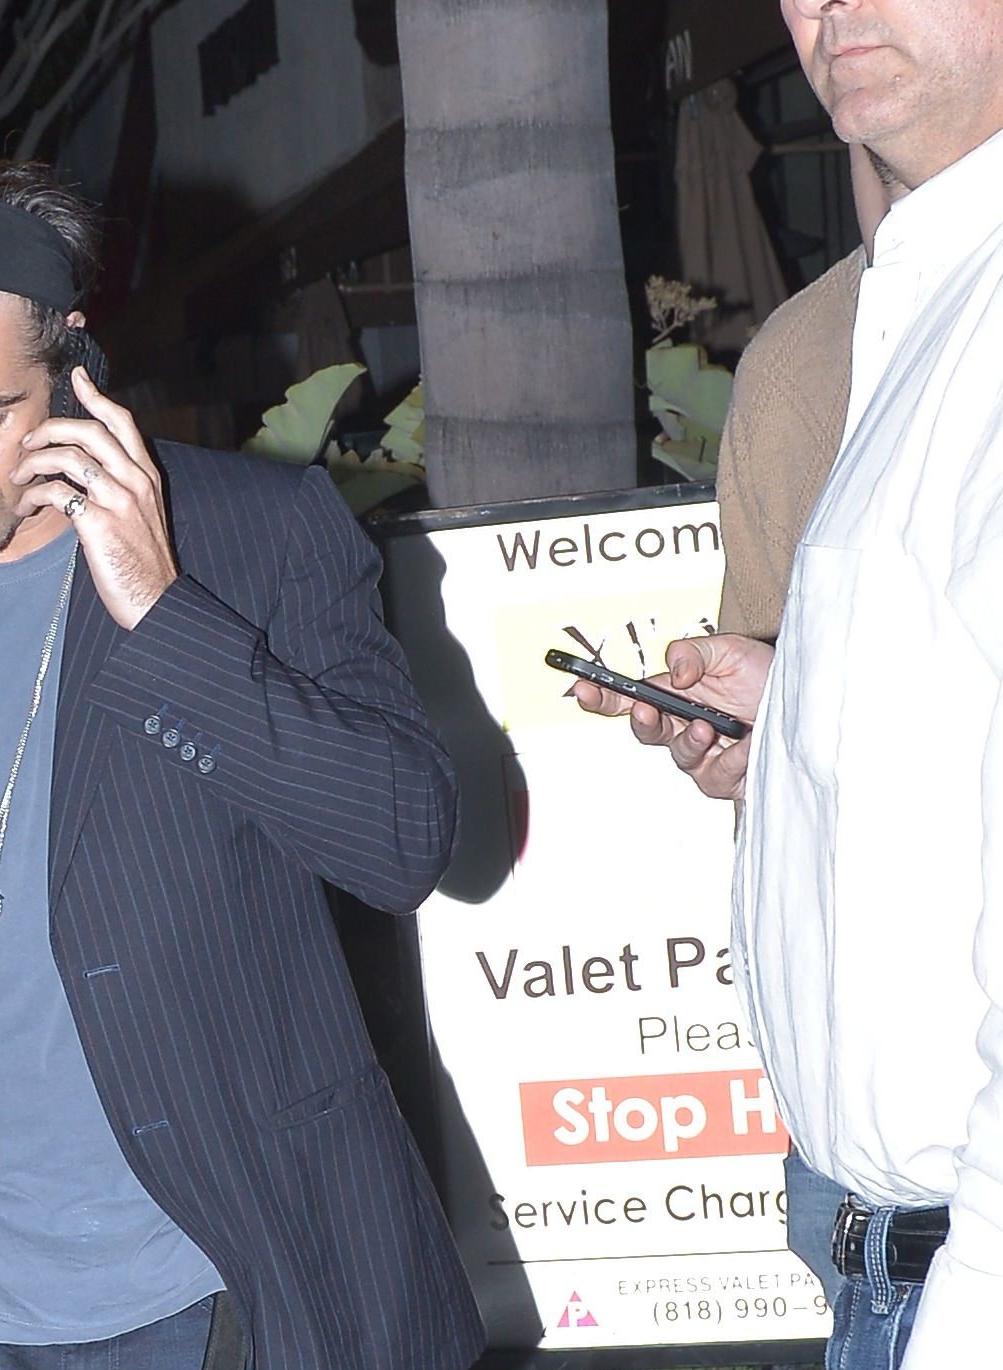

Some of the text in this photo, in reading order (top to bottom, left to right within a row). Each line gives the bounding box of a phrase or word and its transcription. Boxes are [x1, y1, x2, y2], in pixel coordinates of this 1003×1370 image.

[496, 521, 720, 572] Welcom
[474, 943, 642, 1000] Valet
[638, 1015, 755, 1054] Plea
[552, 1086, 707, 1152] Stop
[490, 1188, 647, 1231] Service
[617, 1276, 713, 1295] EXPRESS
[719, 1273, 780, 1291] VALET
[653, 1299, 723, 1326] (818)
